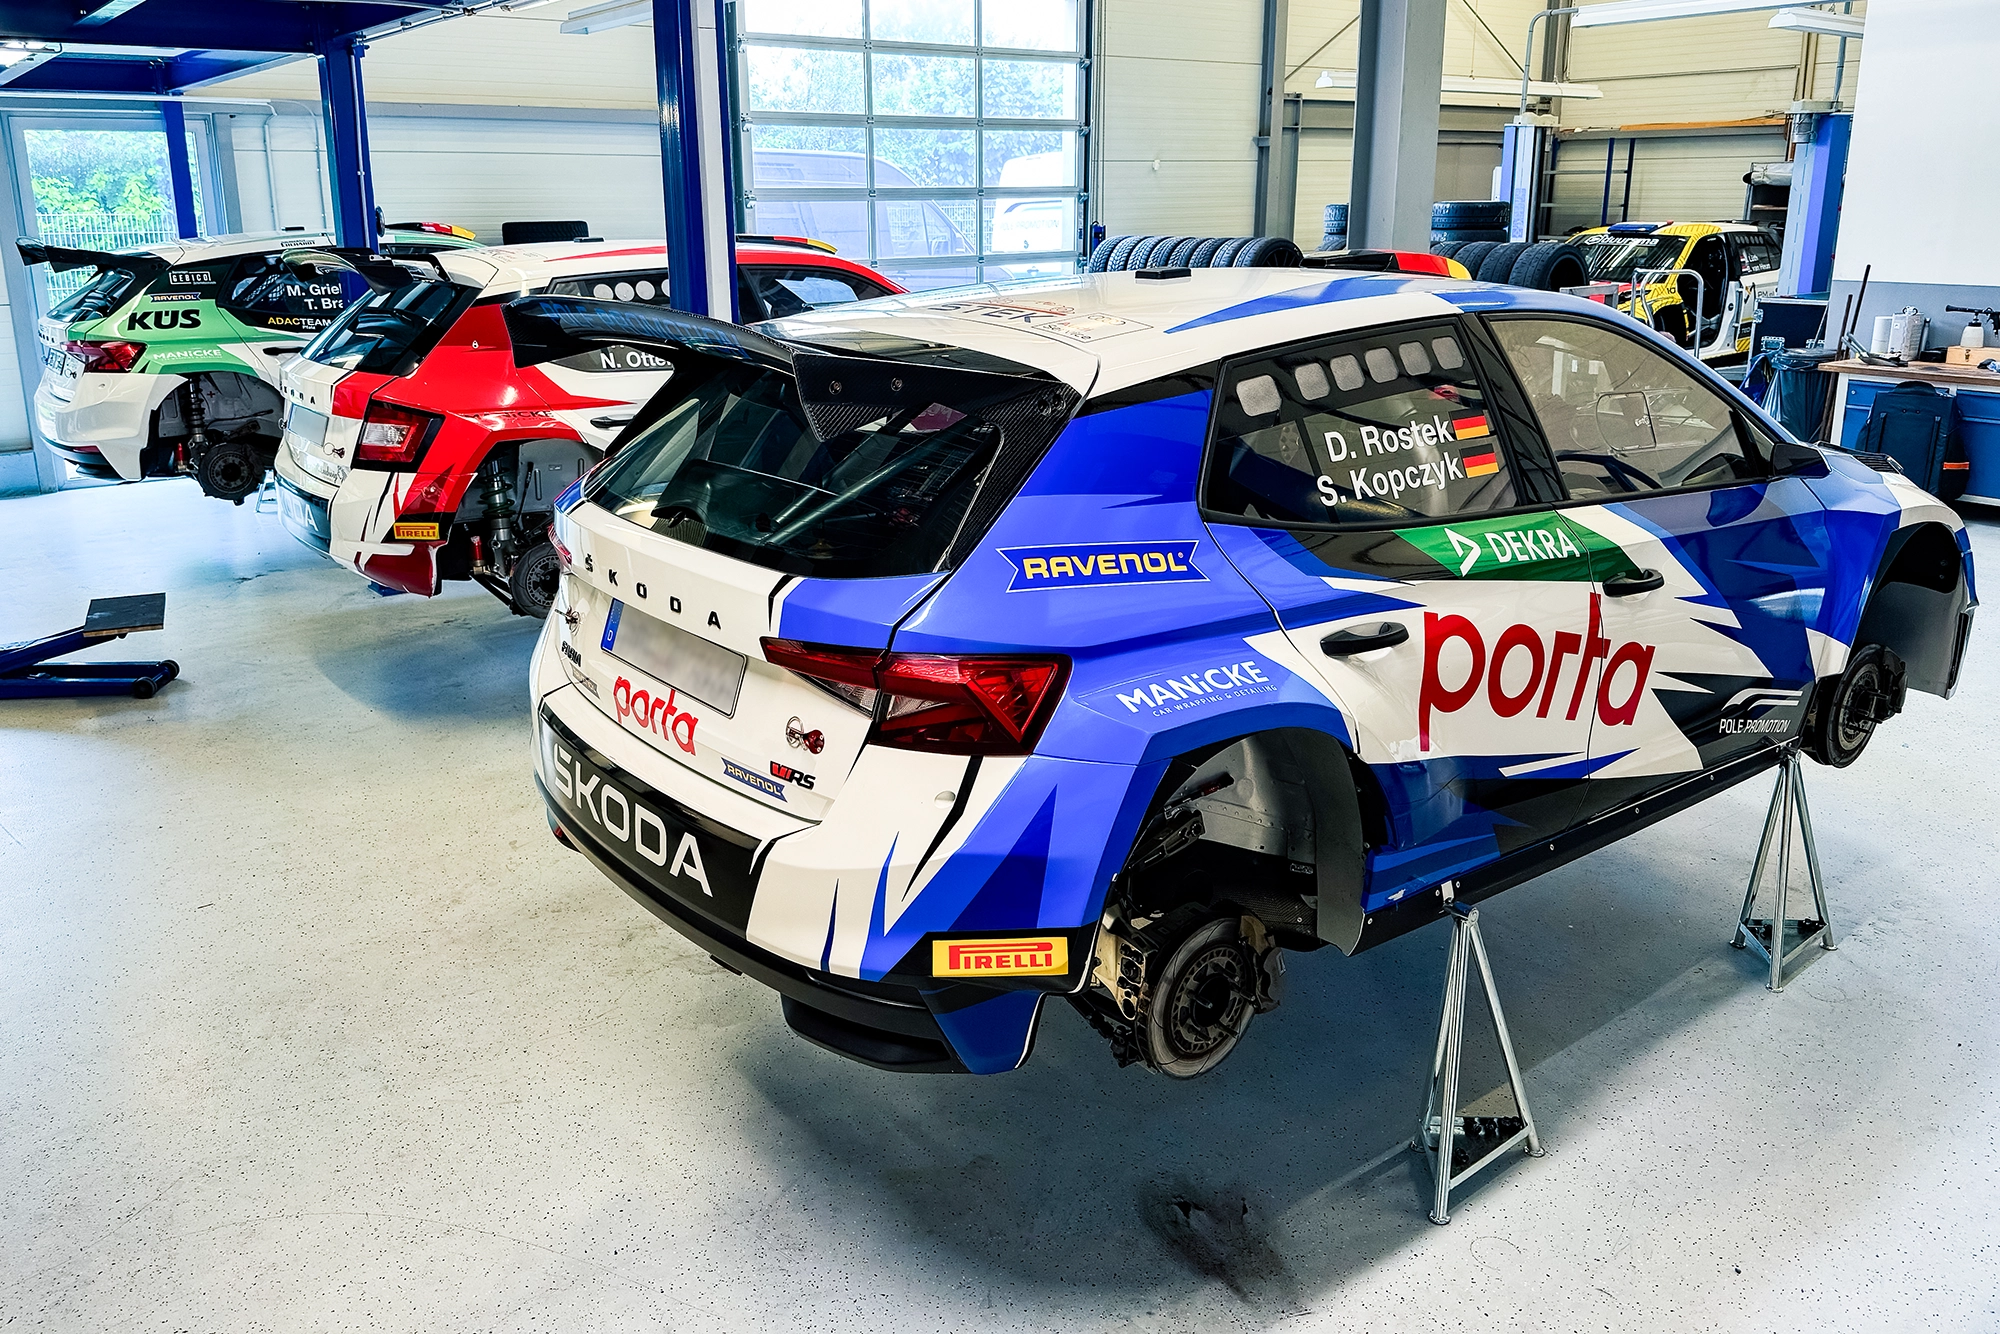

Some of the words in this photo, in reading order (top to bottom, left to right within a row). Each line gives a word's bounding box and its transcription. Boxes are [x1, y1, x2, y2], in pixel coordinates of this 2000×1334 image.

[172, 274, 210, 282] GEBICO
[286, 285, 306, 297] M.
[304, 298, 318, 310] T.
[928, 303, 1057, 323] STEK
[127, 308, 202, 331] KÜS
[600, 352, 622, 369] N.
[626, 351, 672, 368] Otte
[1323, 431, 1357, 463] D.
[1359, 415, 1455, 457] Rostek
[1316, 475, 1347, 507] S.
[1350, 452, 1464, 501] Kopczyk
[395, 525, 436, 537] PIRELLI
[1483, 527, 1581, 564] DEKRA
[1022, 552, 1188, 580] RAVENOL
[584, 554, 722, 630] ŠKODA
[607, 629, 614, 642] D
[1418, 592, 1657, 752] porta
[1152, 707, 1173, 717] CAR
[1174, 694, 1223, 711] WRAPPING
[1224, 691, 1233, 699] &
[1234, 684, 1278, 698] DETAILING
[613, 675, 699, 757] porta
[1718, 718, 1745, 734] POLE
[1744, 719, 1791, 733] PROMOTION
[726, 764, 782, 796] RAVENOL
[948, 942, 1053, 970] PIRELLI
